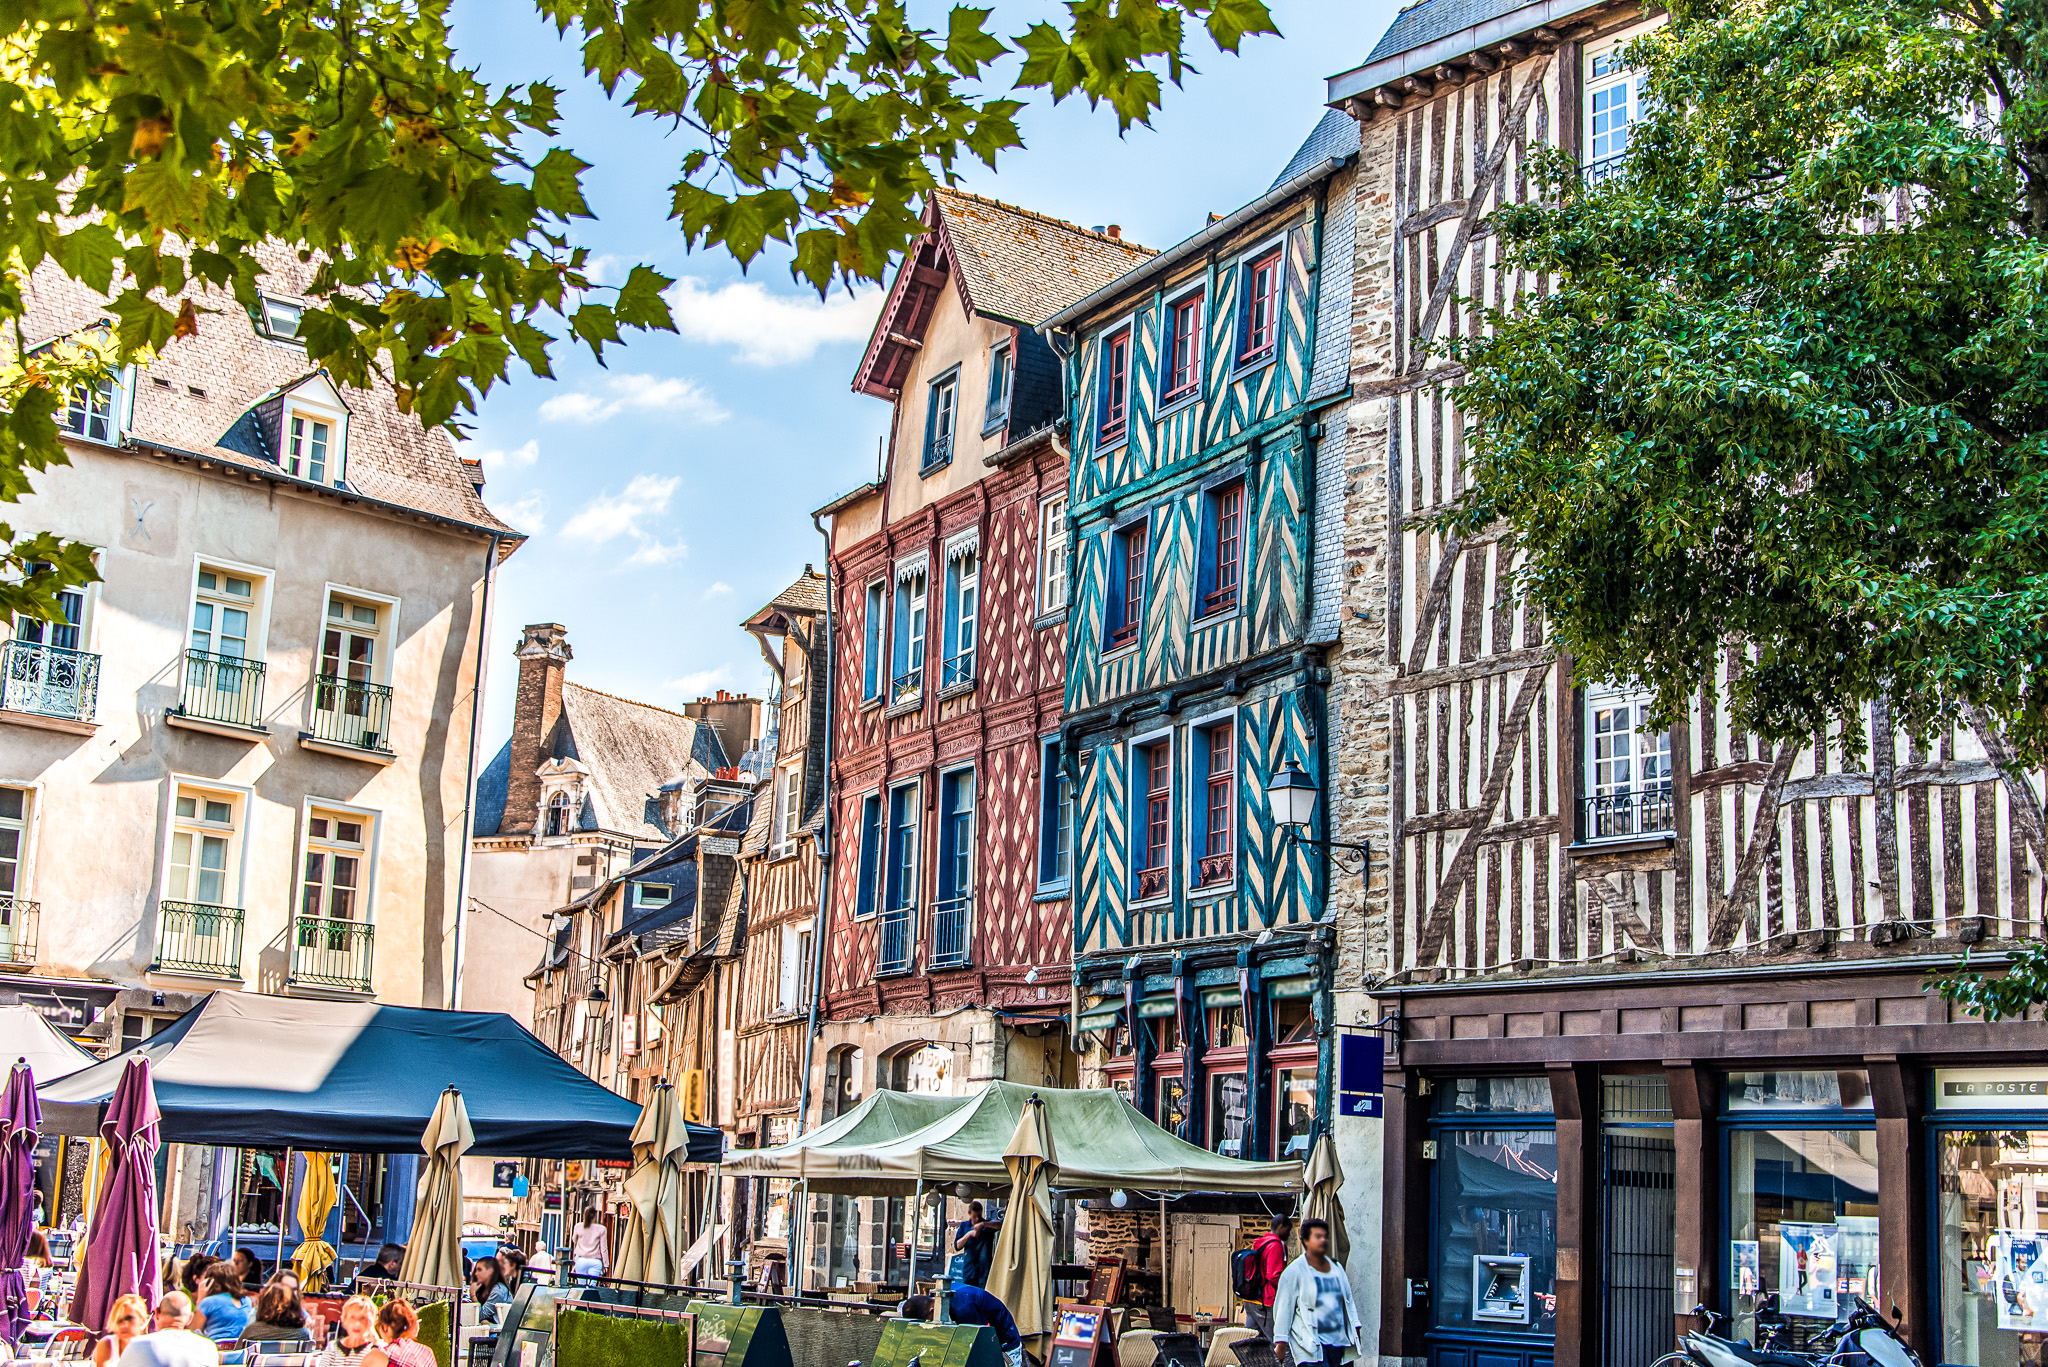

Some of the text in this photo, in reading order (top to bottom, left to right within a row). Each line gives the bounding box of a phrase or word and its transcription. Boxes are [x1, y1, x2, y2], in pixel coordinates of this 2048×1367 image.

[1955, 1083, 2038, 1093] LA POSTE
[837, 1154, 883, 1171] PIZZERIA
